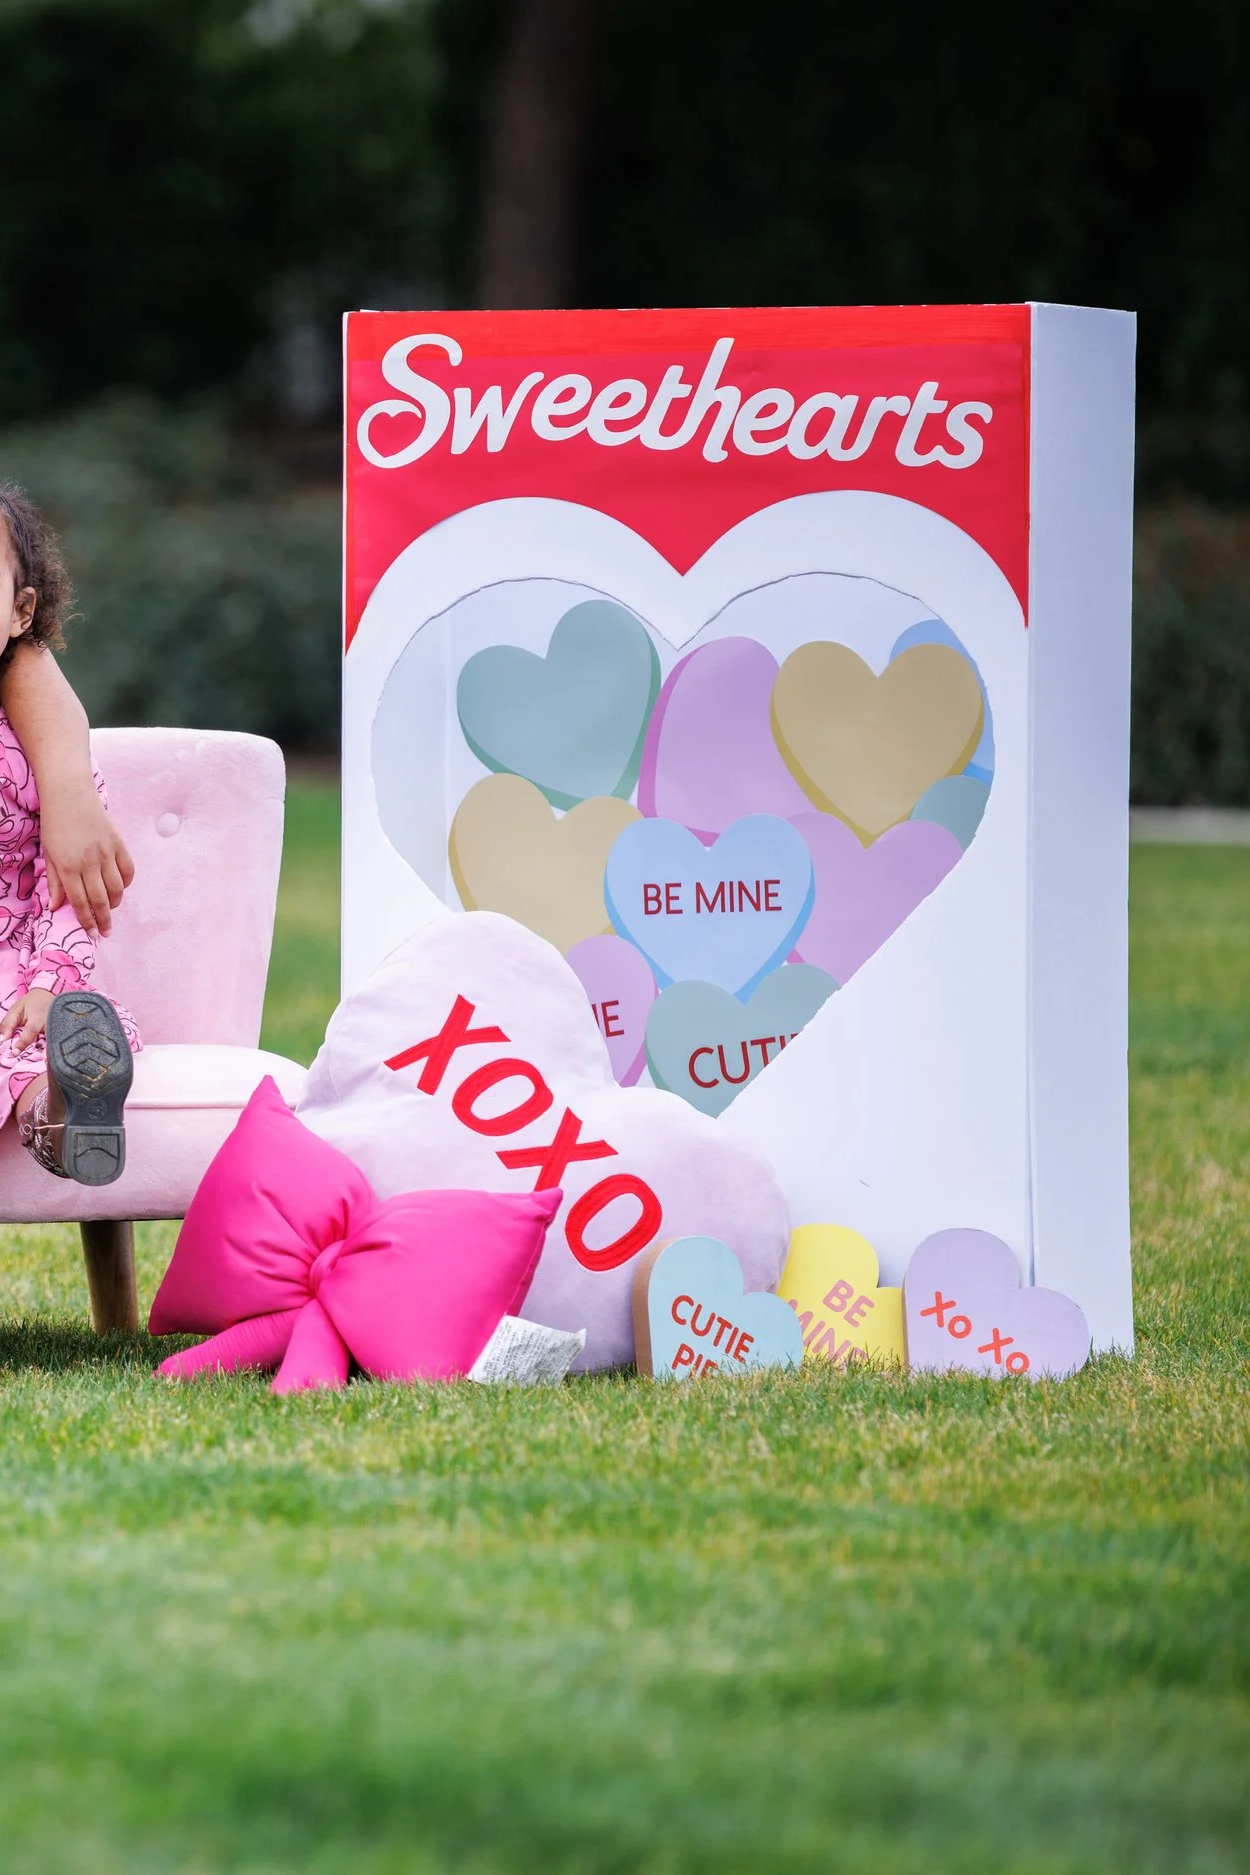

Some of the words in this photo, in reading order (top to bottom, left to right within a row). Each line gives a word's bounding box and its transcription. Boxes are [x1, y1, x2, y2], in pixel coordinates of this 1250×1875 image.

[357, 333, 992, 469] Sweethearts
[643, 875, 683, 916] BE
[695, 879, 782, 914] MINE
[383, 993, 663, 1272] XOXO
[671, 1295, 755, 1363] CUTIE
[822, 1279, 876, 1328] BE
